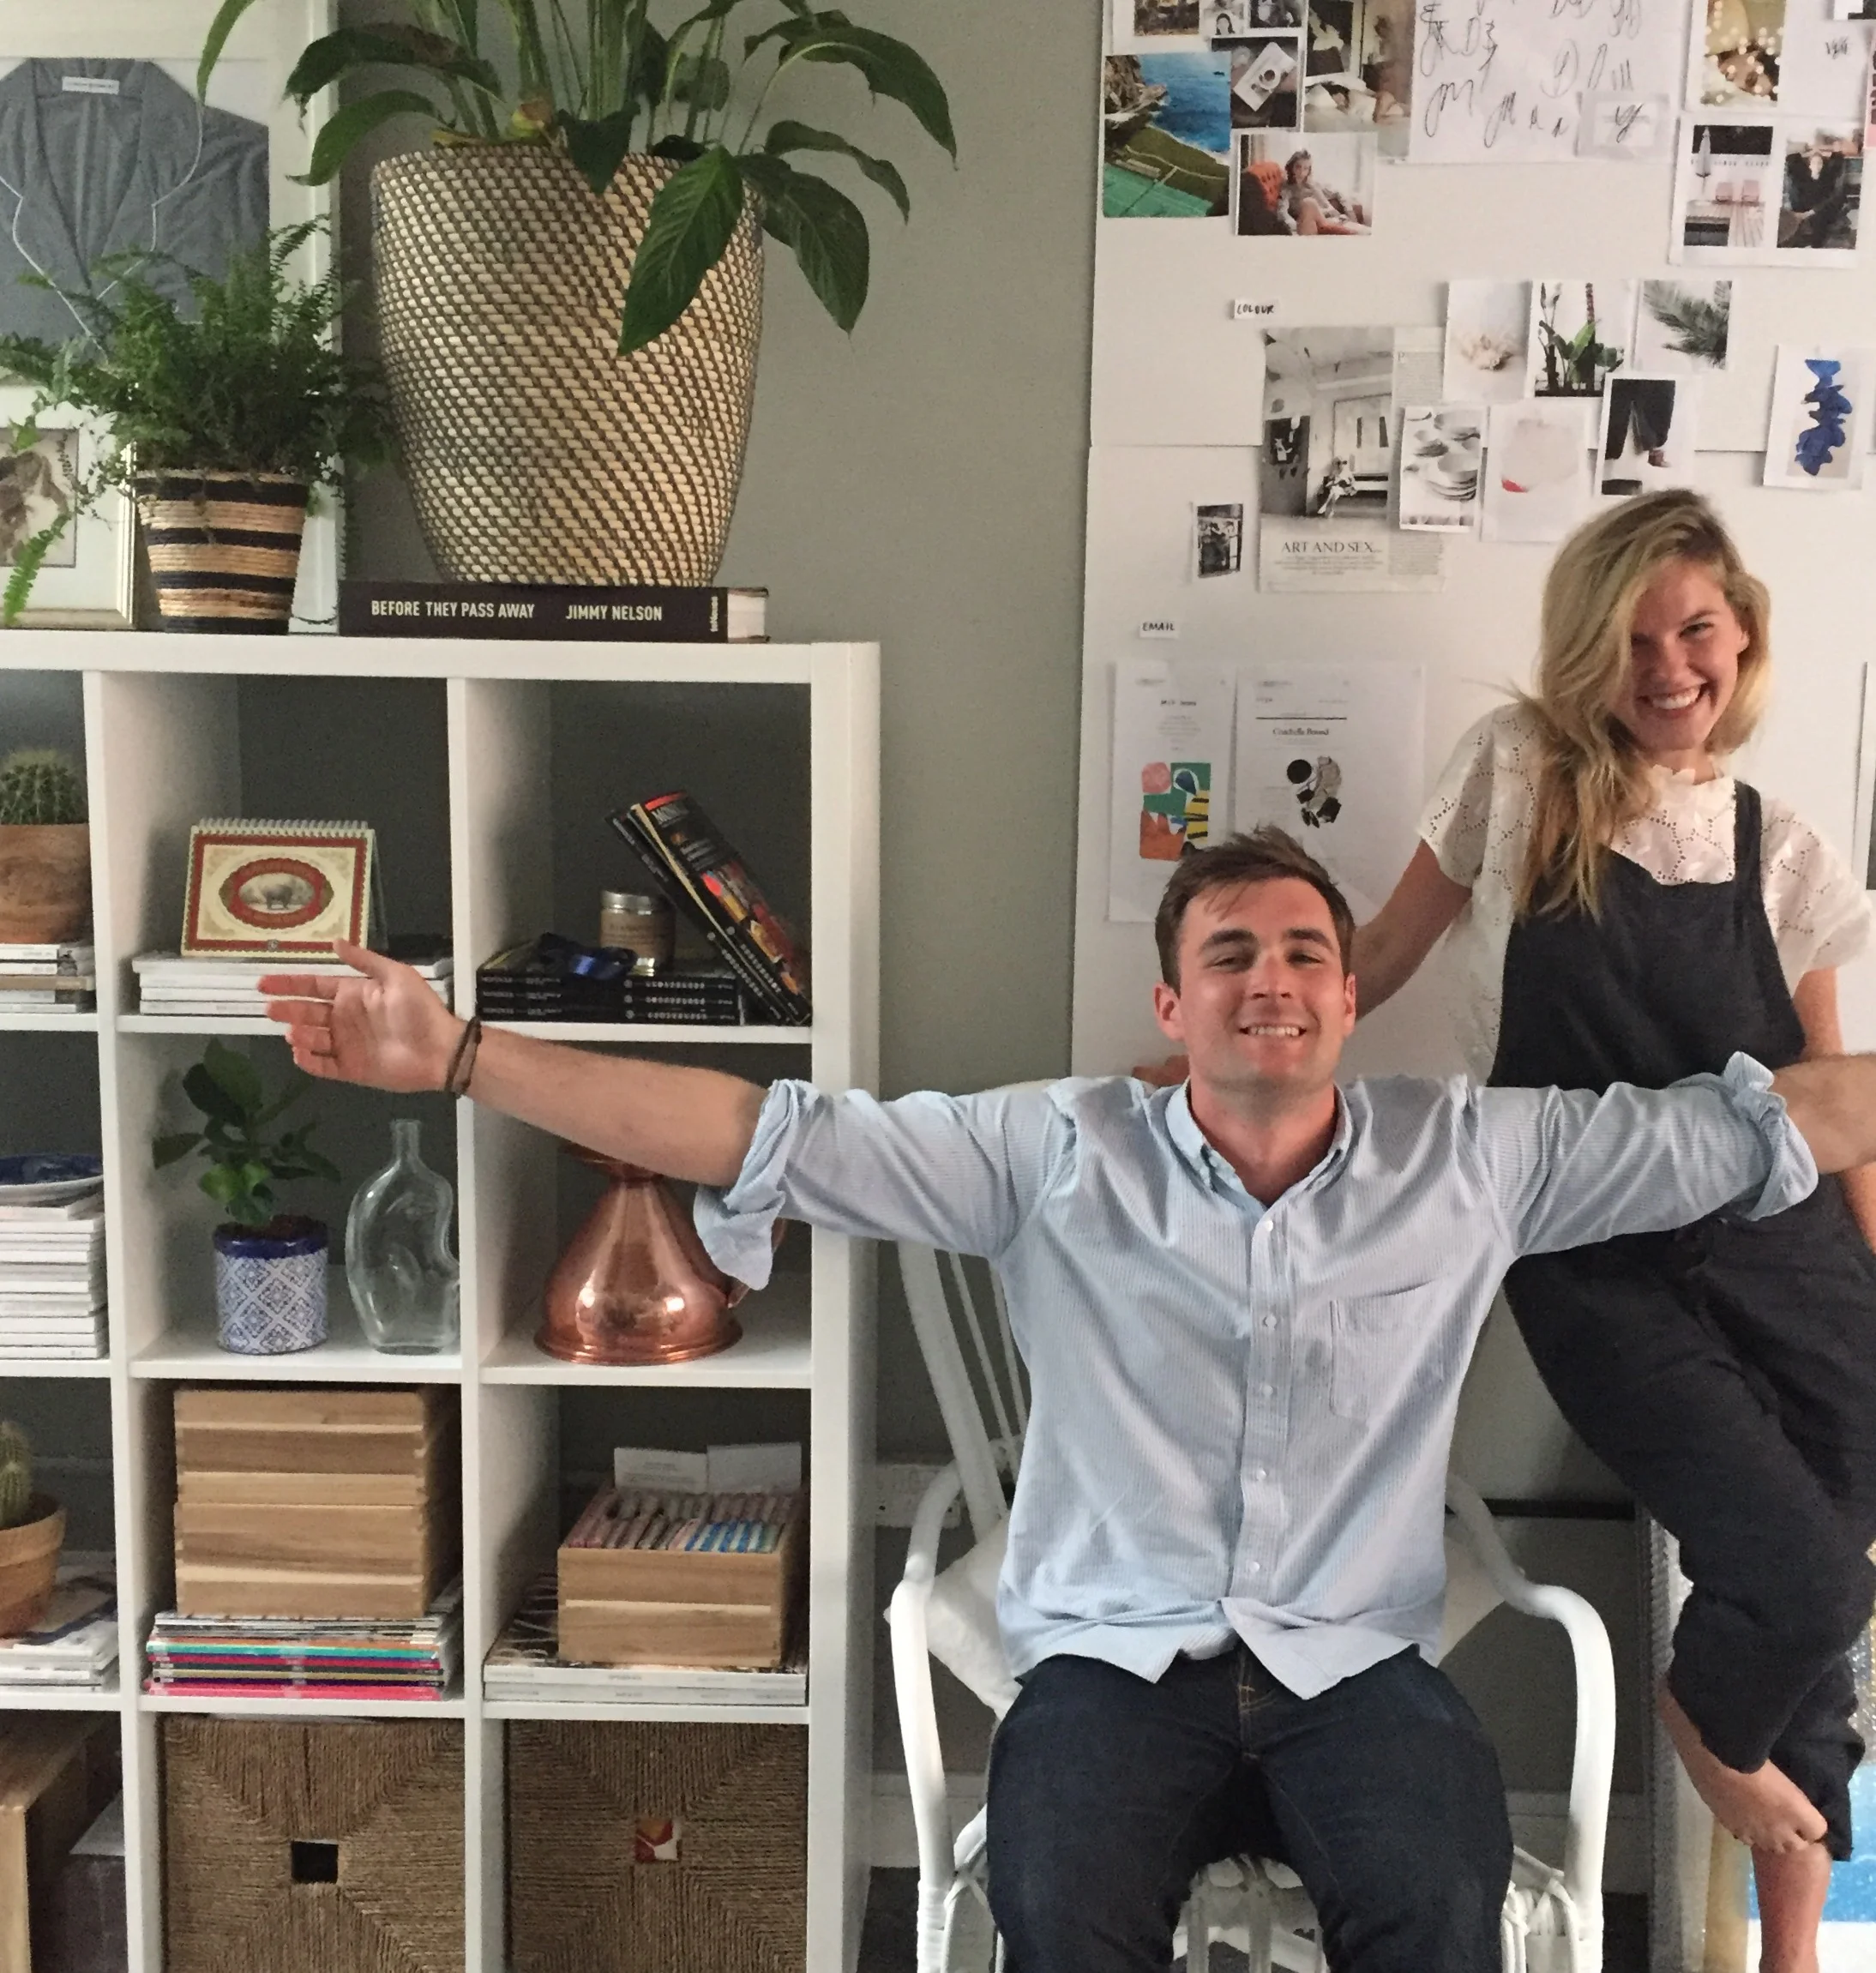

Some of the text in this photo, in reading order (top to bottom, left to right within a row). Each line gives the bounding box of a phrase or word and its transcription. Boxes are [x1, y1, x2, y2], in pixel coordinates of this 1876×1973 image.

[1236, 304, 1274, 315] COLOUR
[1282, 541, 1308, 553] ART
[1313, 541, 1344, 553] AND
[371, 600, 535, 619] BEFORE THEY PASS AWAY
[565, 605, 663, 621] JIMMY NELSON
[1142, 622, 1176, 632] EMAIL
